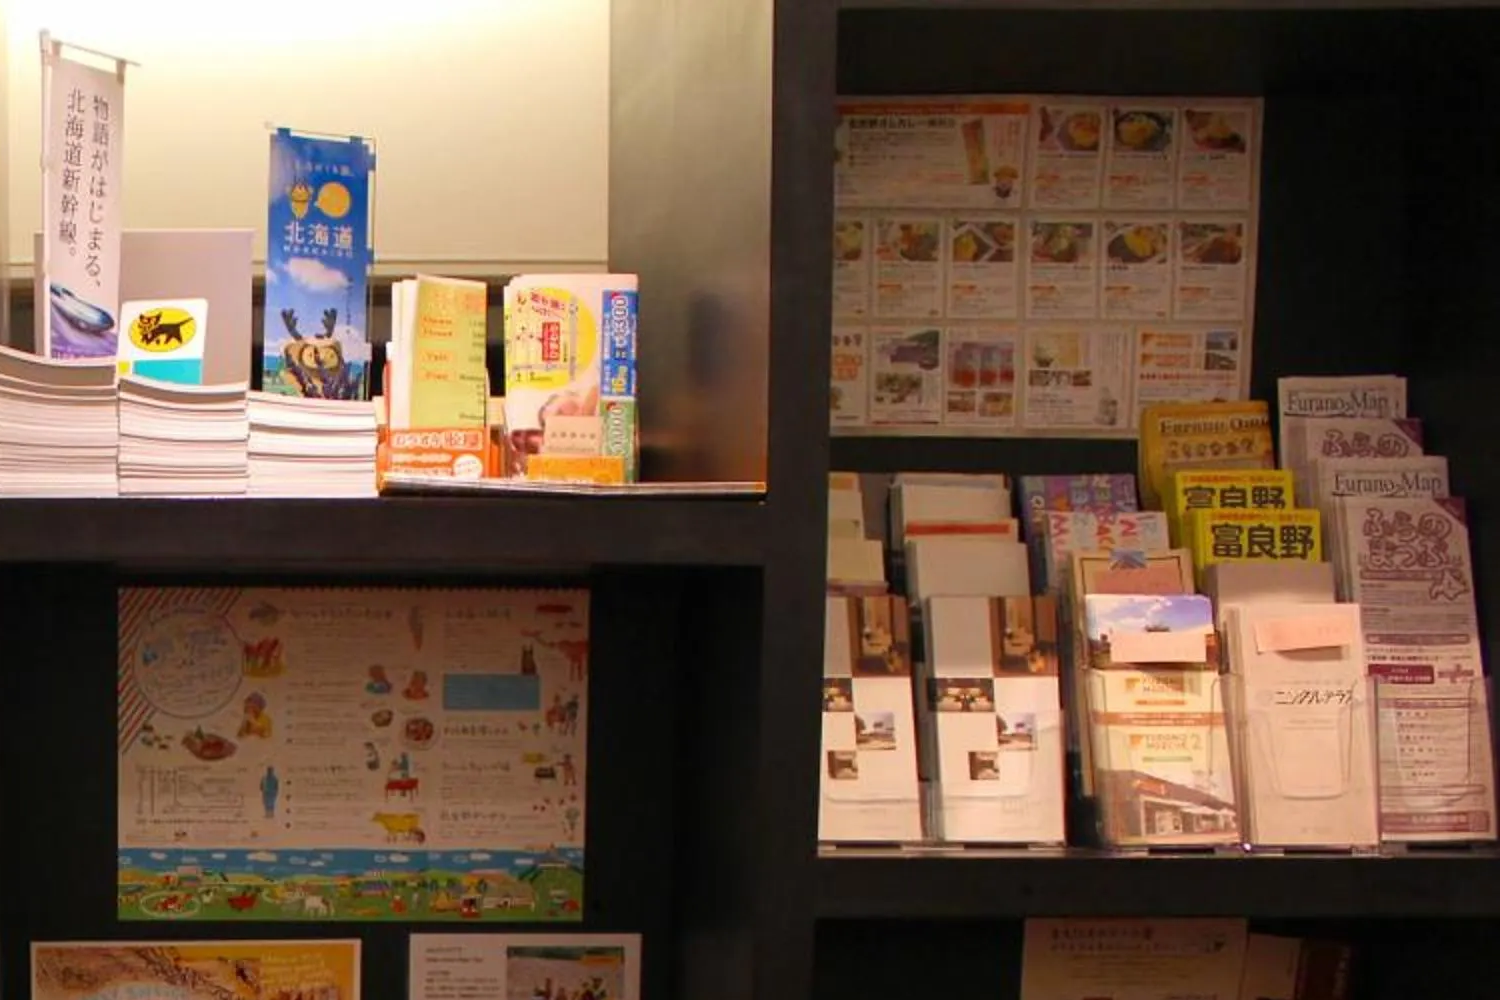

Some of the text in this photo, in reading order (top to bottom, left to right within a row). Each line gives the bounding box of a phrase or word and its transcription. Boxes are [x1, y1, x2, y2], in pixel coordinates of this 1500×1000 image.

[58, 87, 86, 257] 北海道新幹線。
[85, 94, 110, 287] 物語がはじまる、
[284, 222, 354, 250] 北海道
[1211, 522, 1315, 560] 富良野
